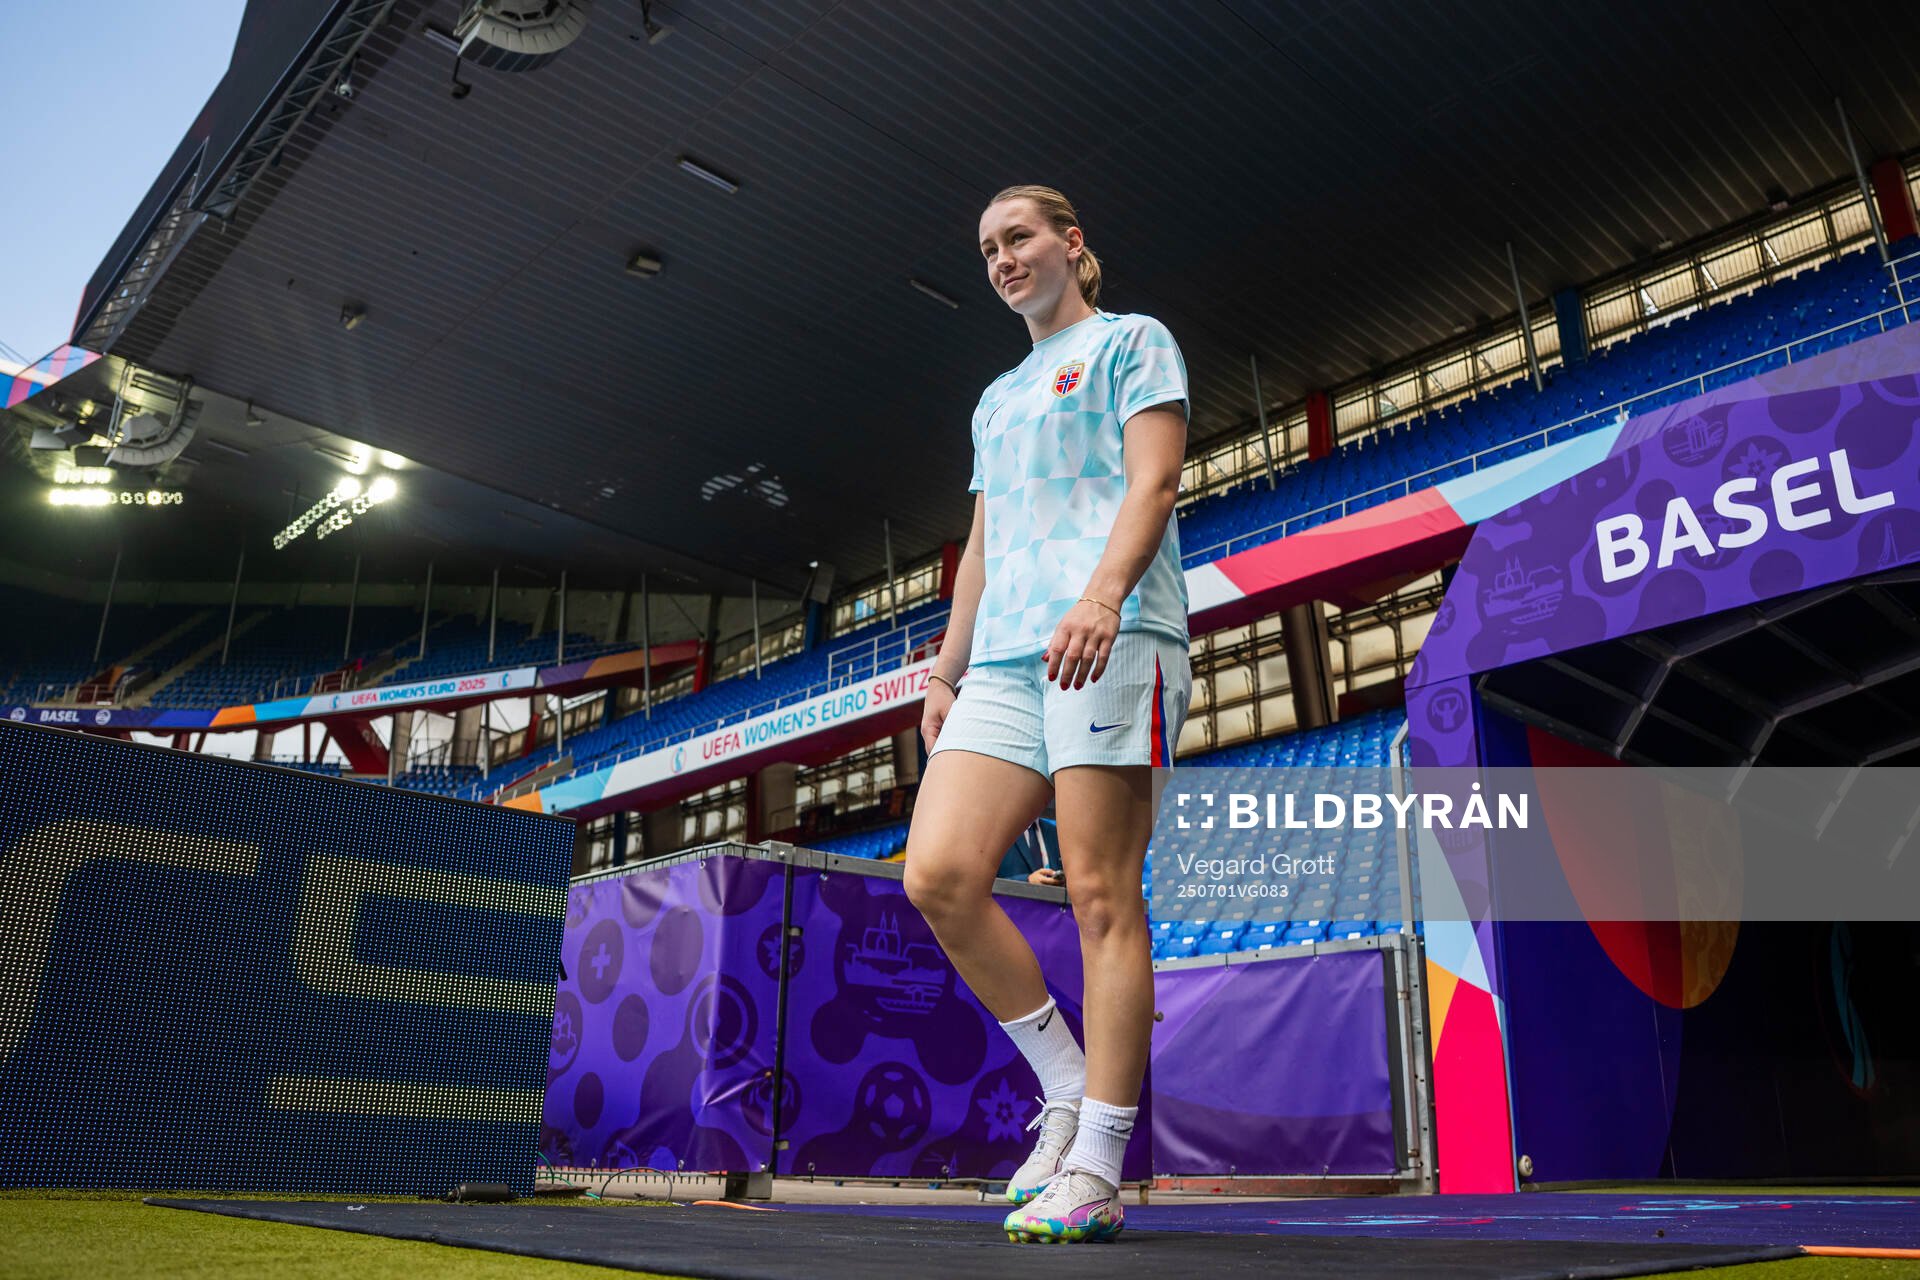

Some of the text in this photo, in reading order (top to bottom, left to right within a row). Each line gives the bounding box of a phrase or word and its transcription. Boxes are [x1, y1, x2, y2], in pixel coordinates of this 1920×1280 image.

[1596, 449, 1896, 584] BASEL
[40, 710, 80, 722] BASEL
[352, 678, 486, 705] UEFA WOMEN'S EURO 2025
[702, 732, 741, 760] UEFA
[743, 704, 817, 746] WOMEN'S
[820, 688, 867, 723] EURO
